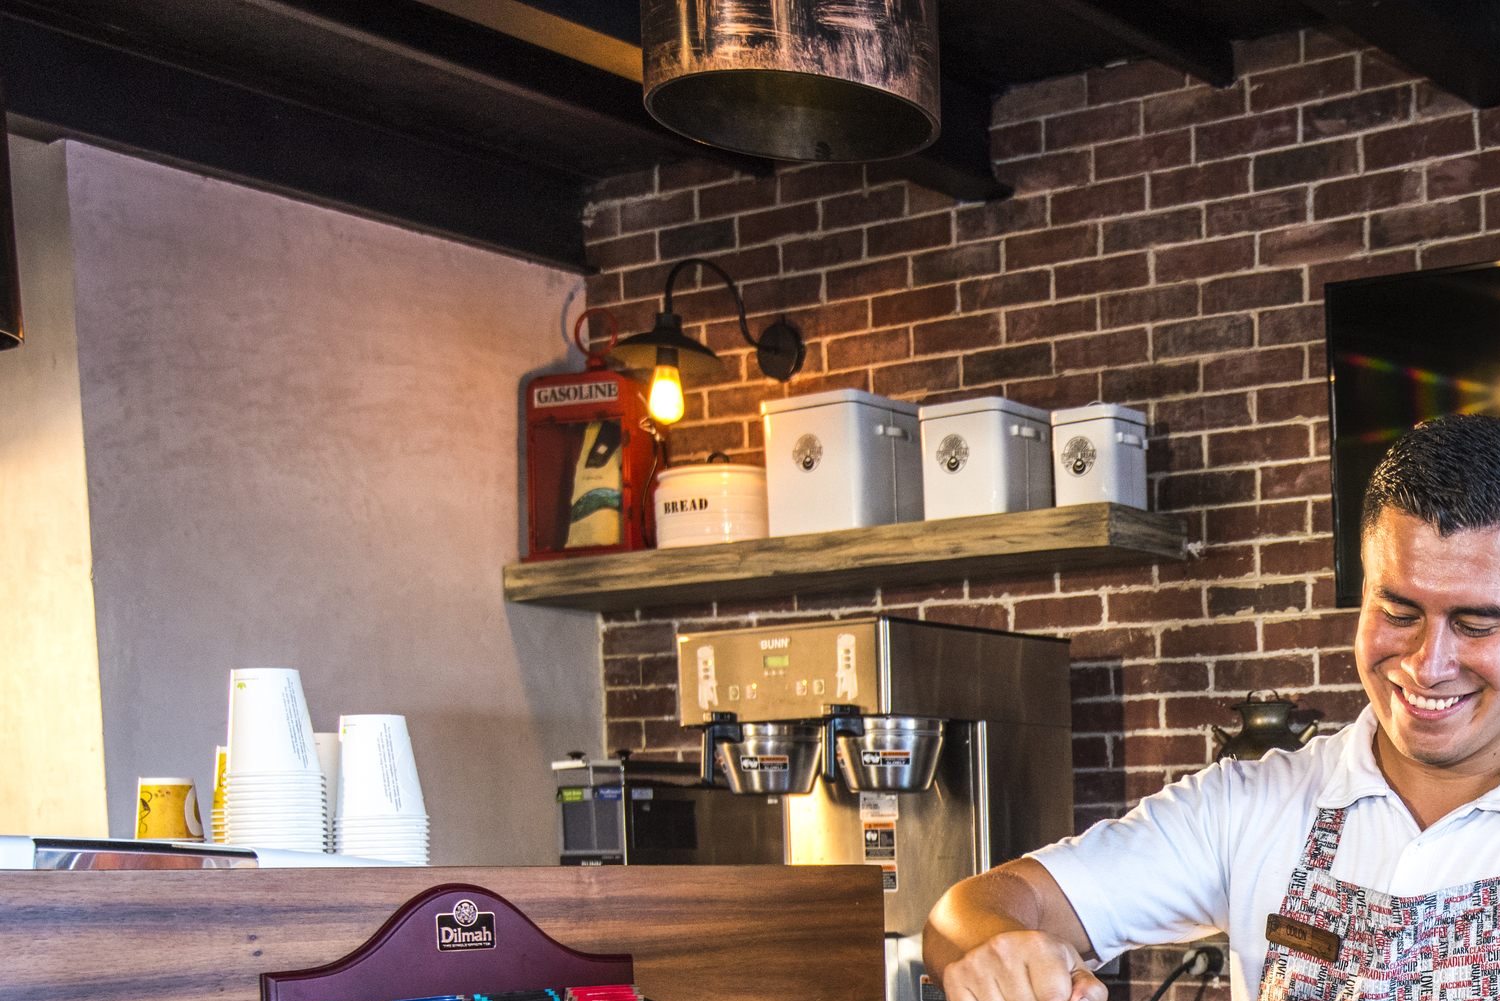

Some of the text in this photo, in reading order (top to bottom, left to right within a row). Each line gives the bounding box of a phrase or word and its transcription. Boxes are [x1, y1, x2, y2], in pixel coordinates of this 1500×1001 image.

[537, 383, 618, 404] GASOLINE
[664, 498, 708, 514] BREAD
[761, 638, 788, 650] BUNN
[440, 927, 492, 943] Dilmah
[1453, 947, 1469, 955] DARK
[1470, 942, 1497, 955] CLASSIC
[1403, 962, 1418, 973] CUP
[1439, 953, 1486, 969] TRADITIONAL
[1363, 966, 1402, 981] TRADITIONAL
[1471, 963, 1481, 996] QUALITY
[1421, 970, 1433, 996] LOVE
[1440, 979, 1472, 989] MACCHIATO
[1482, 977, 1490, 997] MOCHA
[1490, 975, 1498, 997] RETRO
